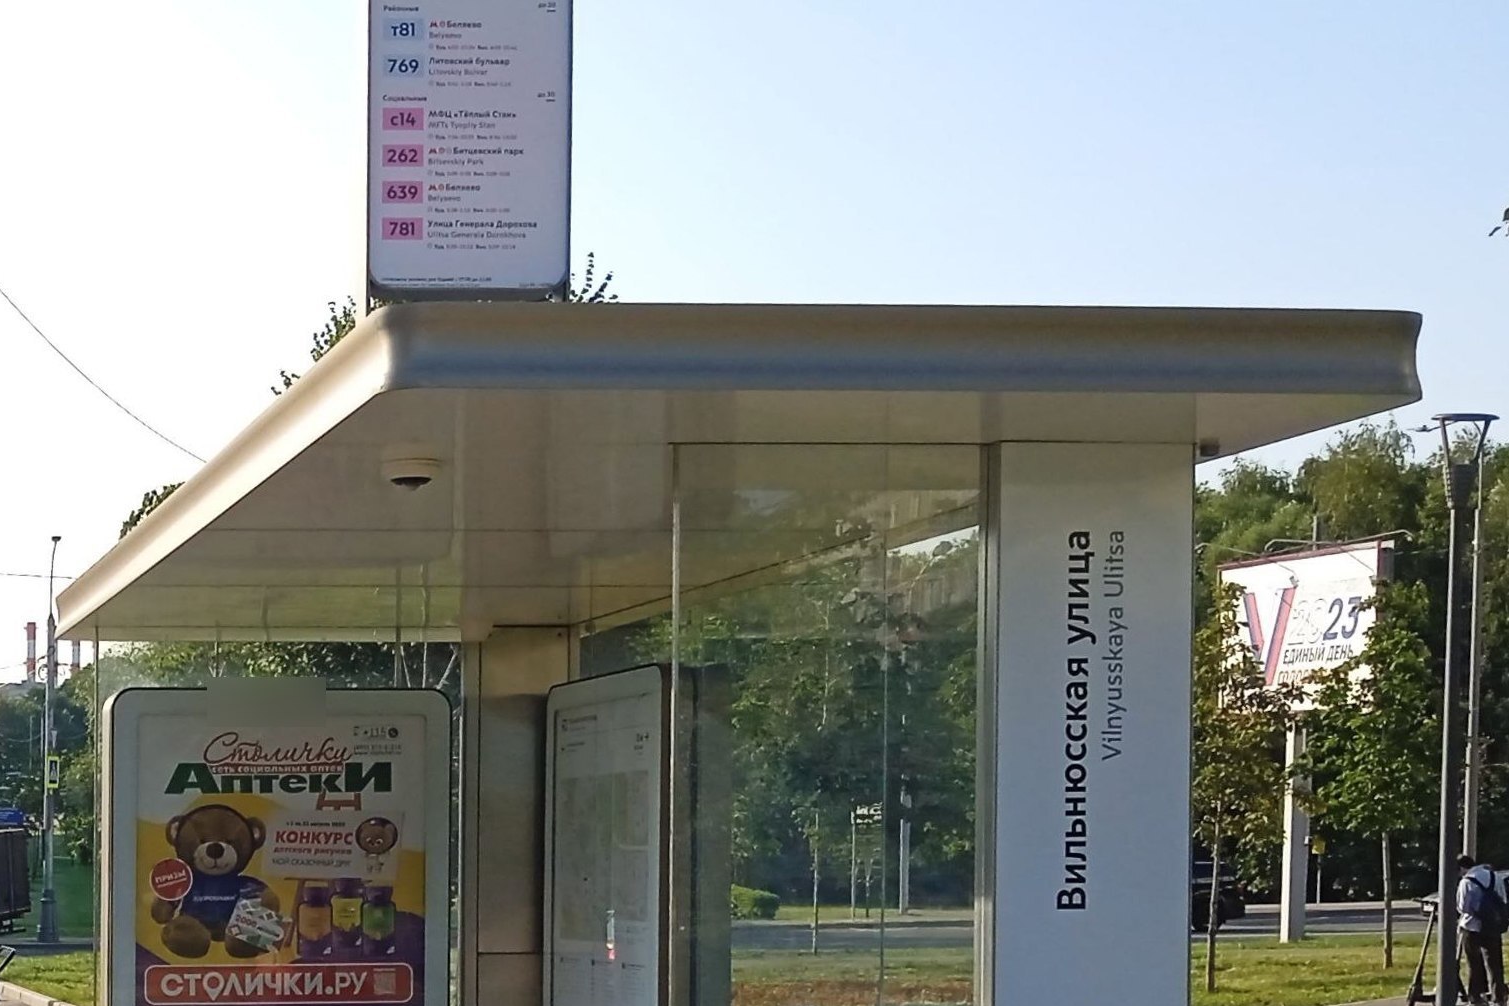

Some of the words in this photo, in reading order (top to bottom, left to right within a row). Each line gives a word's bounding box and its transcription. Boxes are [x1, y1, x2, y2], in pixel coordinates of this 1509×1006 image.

[388, 59, 419, 73] 769
[429, 57, 473, 65] Литовский
[475, 57, 510, 67] бульвар
[387, 149, 418, 163] 262
[453, 147, 502, 155] Битцевский
[387, 185, 418, 200] 639
[389, 222, 415, 236] 781
[428, 220, 452, 228] Улица
[455, 220, 494, 229] Генерала
[496, 220, 537, 229] Дорохова
[1103, 529, 1125, 598] Ulitsa
[1067, 529, 1096, 645] улица
[1283, 643, 1326, 665] ЕДИНЫЙ
[1326, 644, 1353, 663] ДЕНЬ
[1101, 606, 1129, 761] Vilnyusskaya
[203, 731, 353, 764] Столички
[212, 766, 236, 774] сеть
[238, 765, 307, 775] социальных
[310, 765, 343, 773] аптек
[1056, 656, 1090, 911] Вильнюсская
[275, 830, 354, 846] КОНКУРС
[160, 971, 368, 1001] СТОЛИЧКИ.РУ
